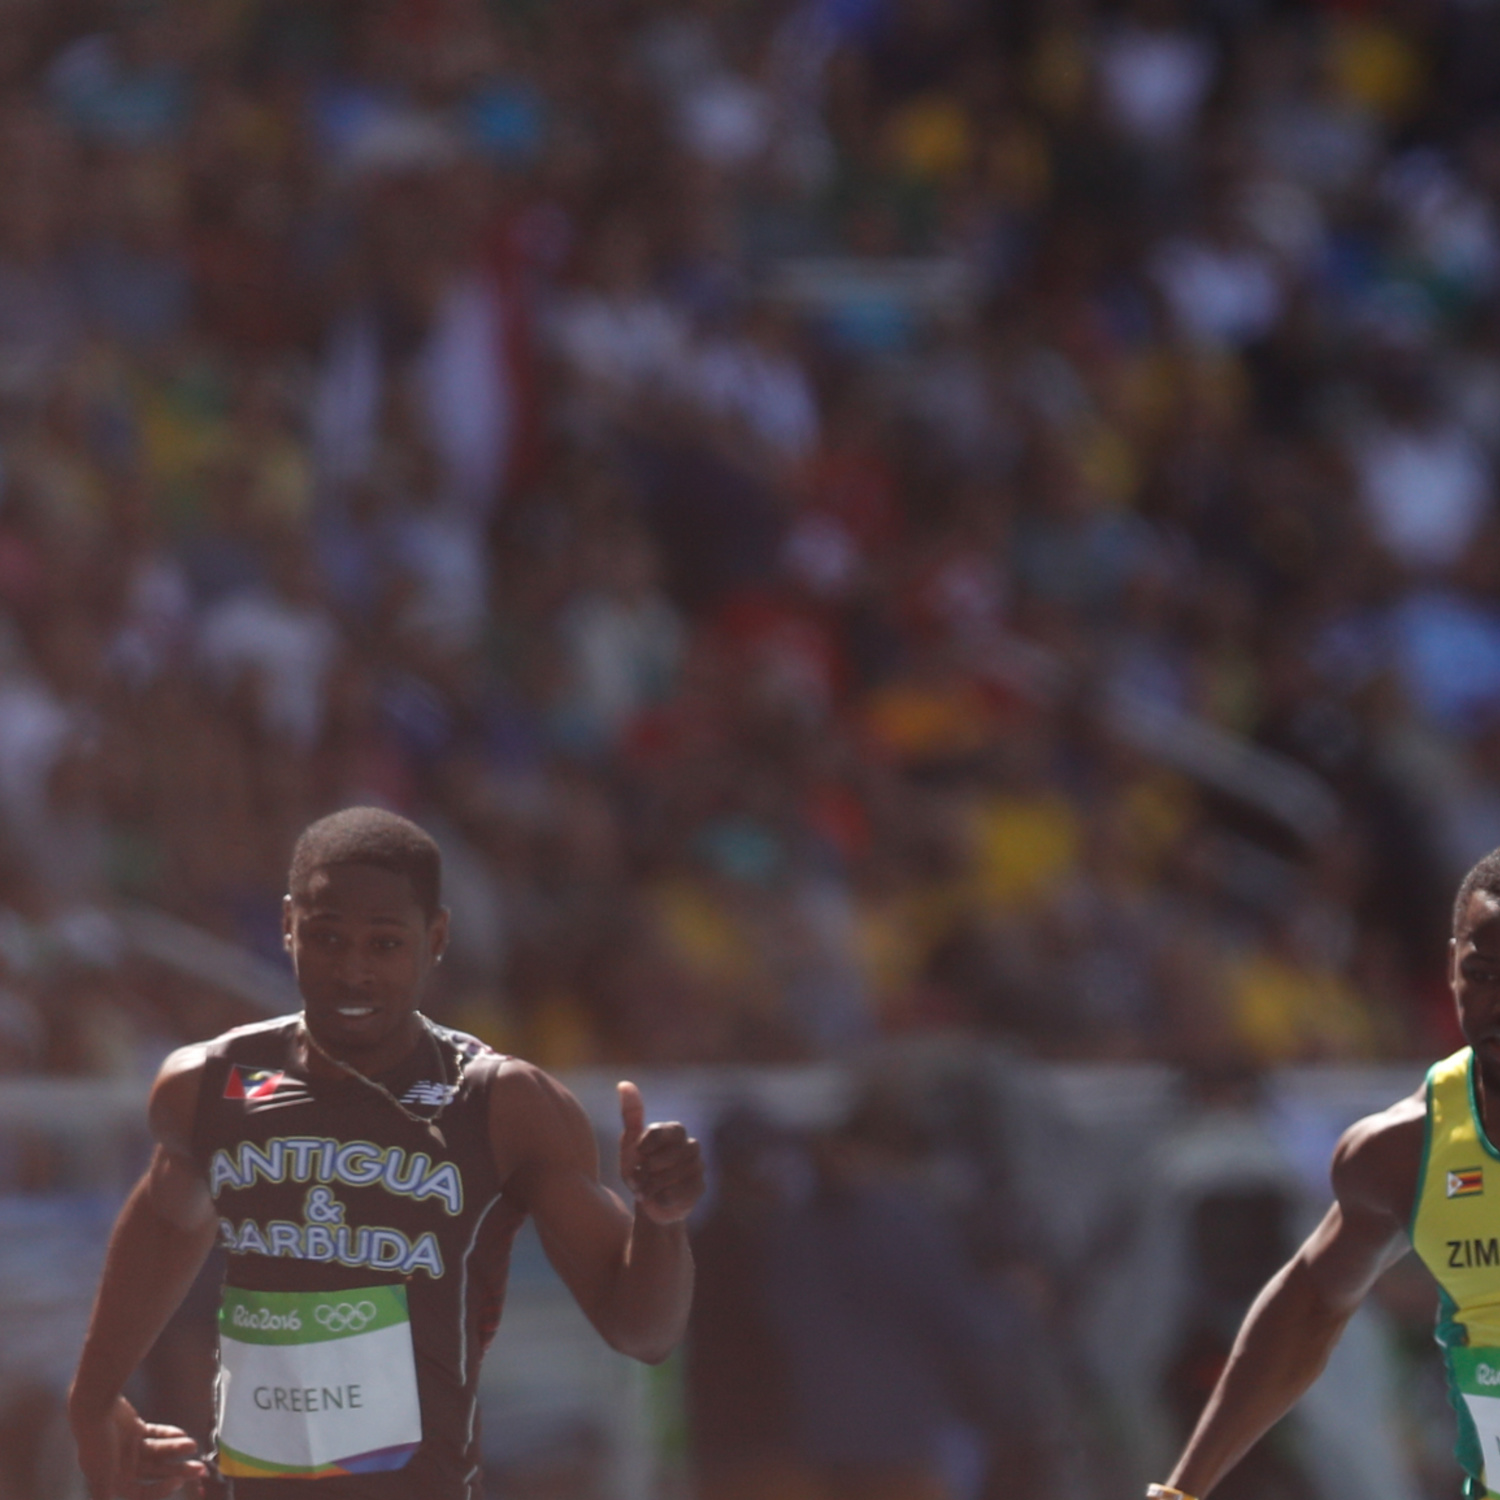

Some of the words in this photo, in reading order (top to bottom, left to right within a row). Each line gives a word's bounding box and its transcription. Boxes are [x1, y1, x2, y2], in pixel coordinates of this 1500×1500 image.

[210, 1138, 464, 1214] ANTIGUA
[305, 1186, 345, 1225] &
[253, 1384, 363, 1412] GREENE
